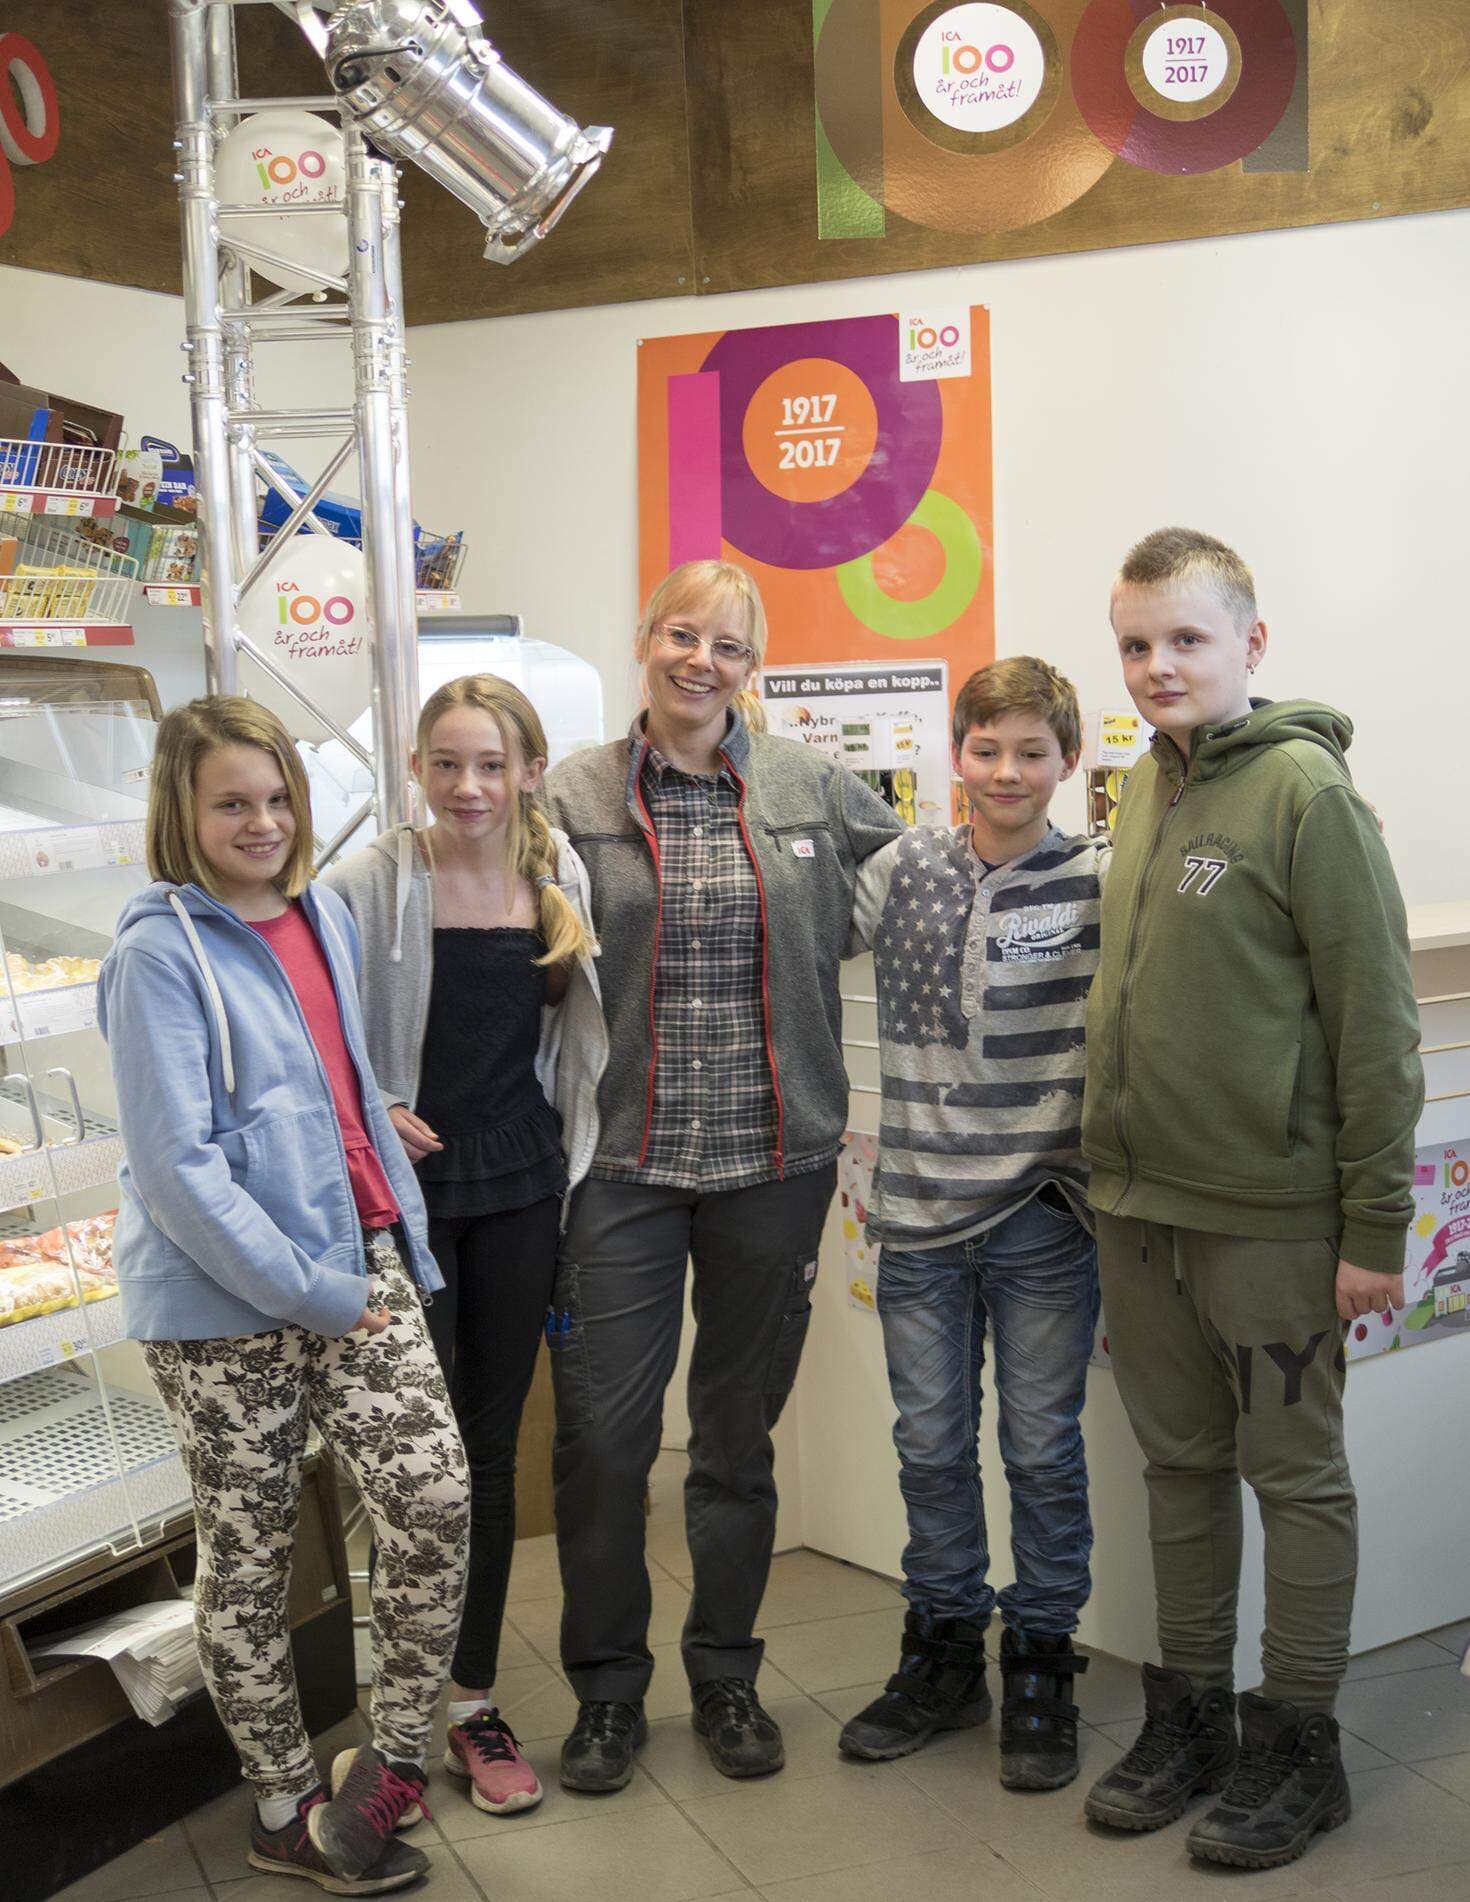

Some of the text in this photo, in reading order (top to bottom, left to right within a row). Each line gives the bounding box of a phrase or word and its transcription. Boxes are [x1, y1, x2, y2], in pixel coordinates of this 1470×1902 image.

[941, 31, 961, 42] ICA
[1167, 37, 1205, 55] 1917
[942, 44, 1015, 74] 100
[935, 71, 989, 93] år och
[1165, 65, 1208, 83] 2017
[950, 79, 1022, 107] framåt!
[252, 147, 272, 160] ICA
[256, 150, 326, 190] 100
[283, 181, 308, 202] och
[910, 325, 960, 350] 100
[920, 346, 942, 361] och
[782, 394, 837, 425] 1917
[779, 438, 841, 469] 2017
[276, 582, 300, 592] ICA
[278, 595, 354, 625] 100
[274, 625, 329, 645] år och
[289, 637, 363, 659] framåt!
[768, 674, 940, 693] Vill du köpa en kopp..
[790, 715, 837, 729] ..Nybr
[1177, 856, 1228, 896] 77
[1444, 1149, 1457, 1160] ICA
[1444, 1159, 1470, 1189] 10
